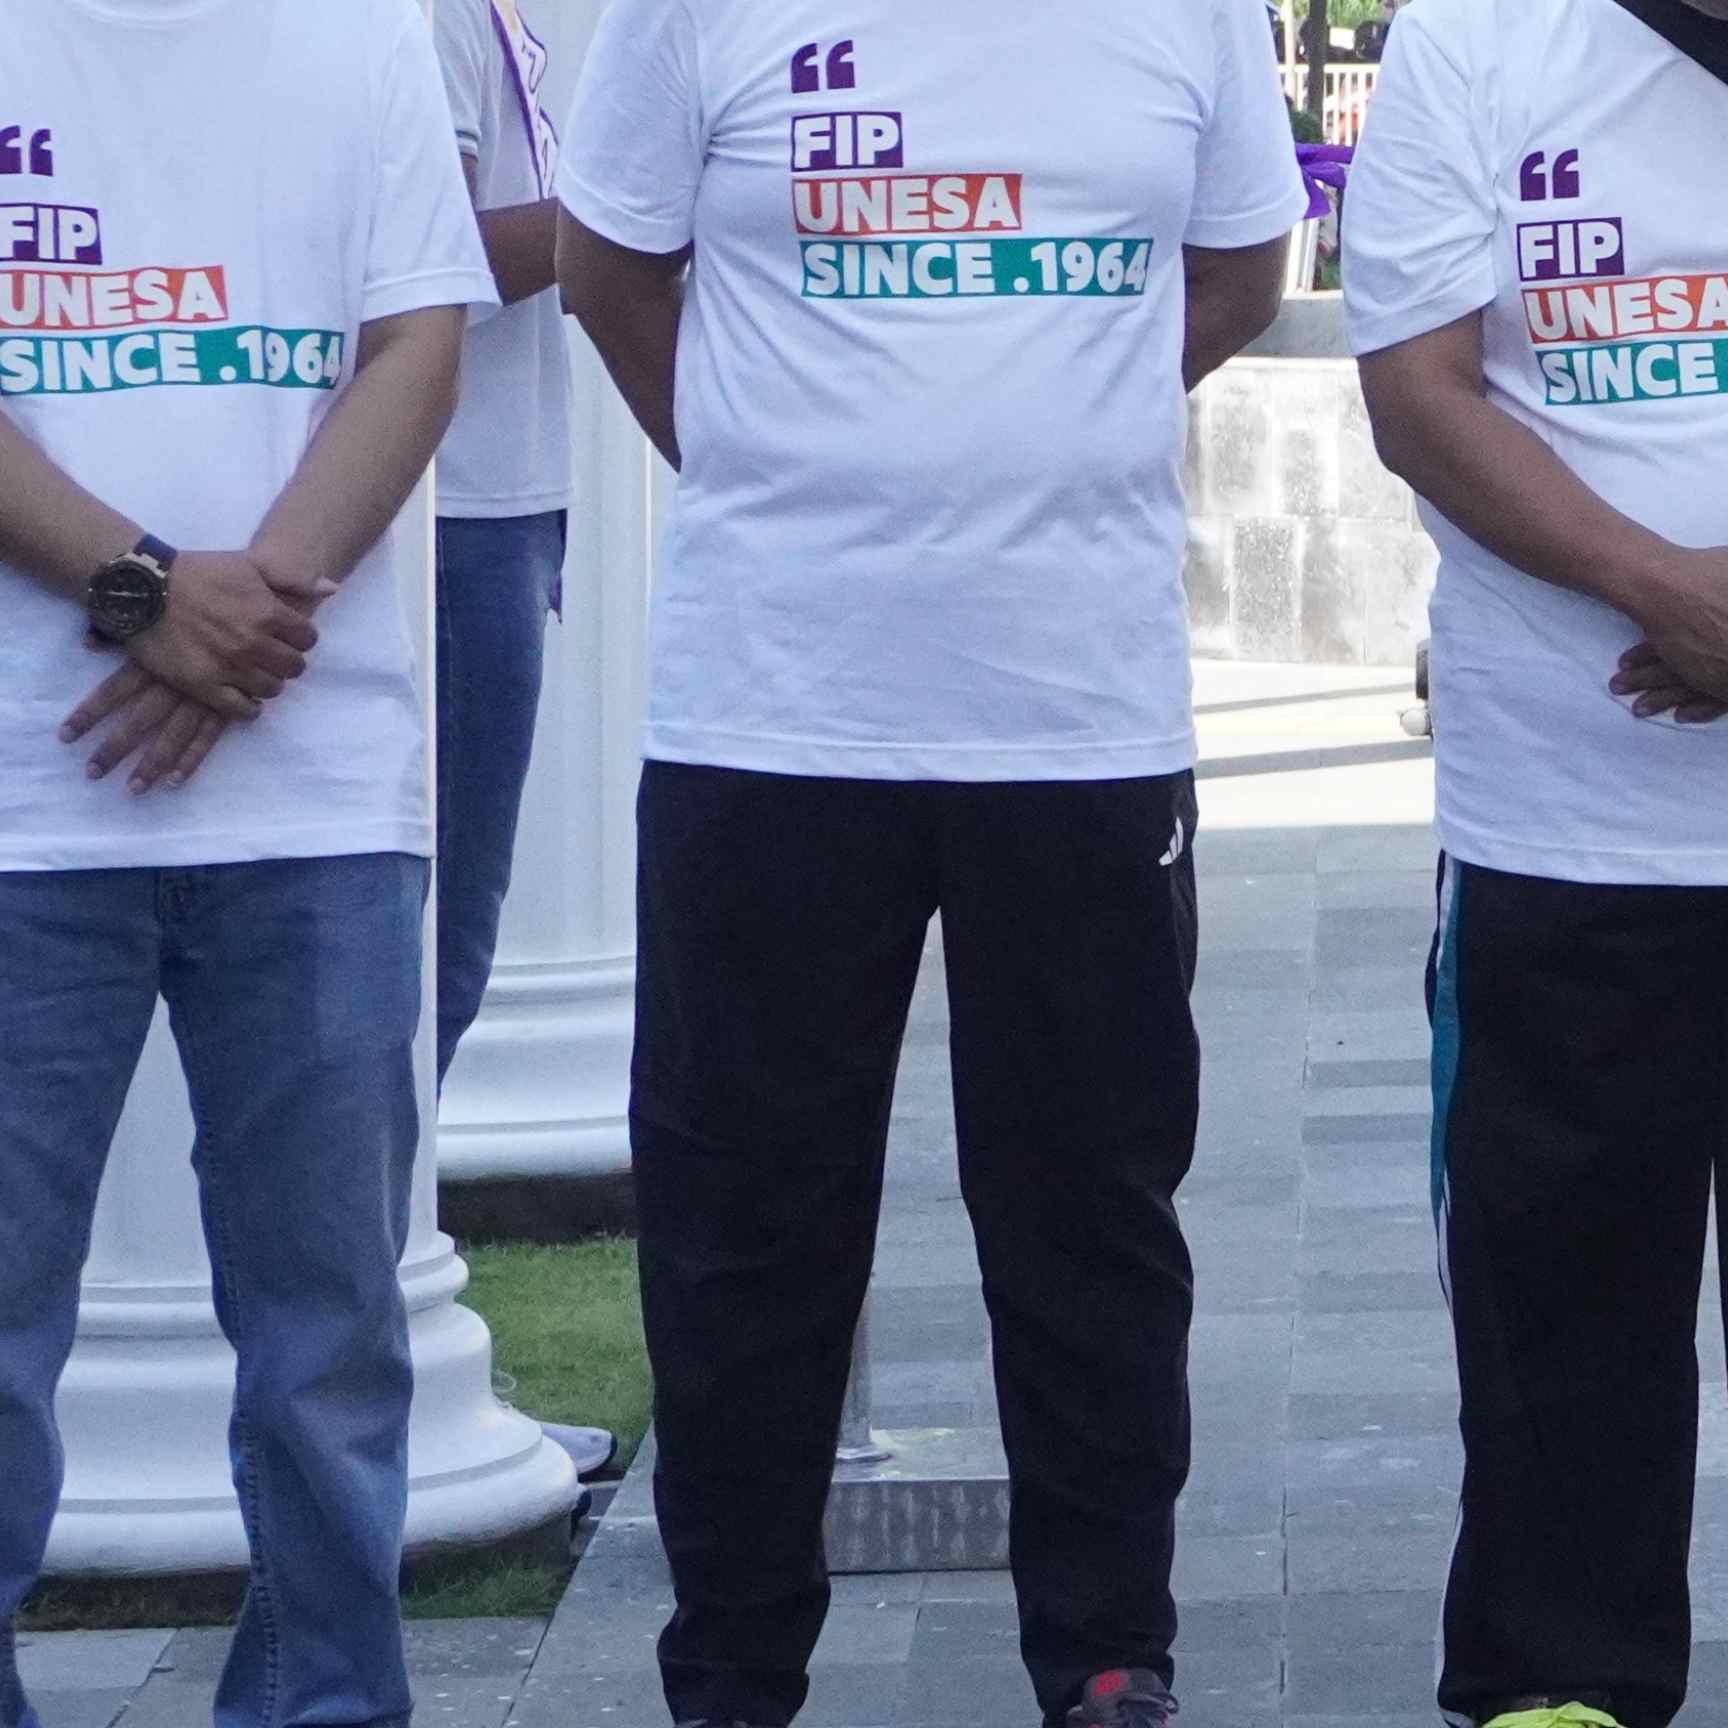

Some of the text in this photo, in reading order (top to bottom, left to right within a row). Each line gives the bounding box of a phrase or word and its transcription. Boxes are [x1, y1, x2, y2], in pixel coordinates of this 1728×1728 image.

[793, 115, 899, 168] FIP
[796, 177, 1020, 231] UNESA
[0, 205, 97, 260] FIP
[1520, 220, 1620, 279] FIP
[803, 242, 994, 296] SINCE
[0, 270, 226, 325] UNESA
[0, 330, 200, 392] SINCE
[1542, 342, 1714, 404] SINCE
